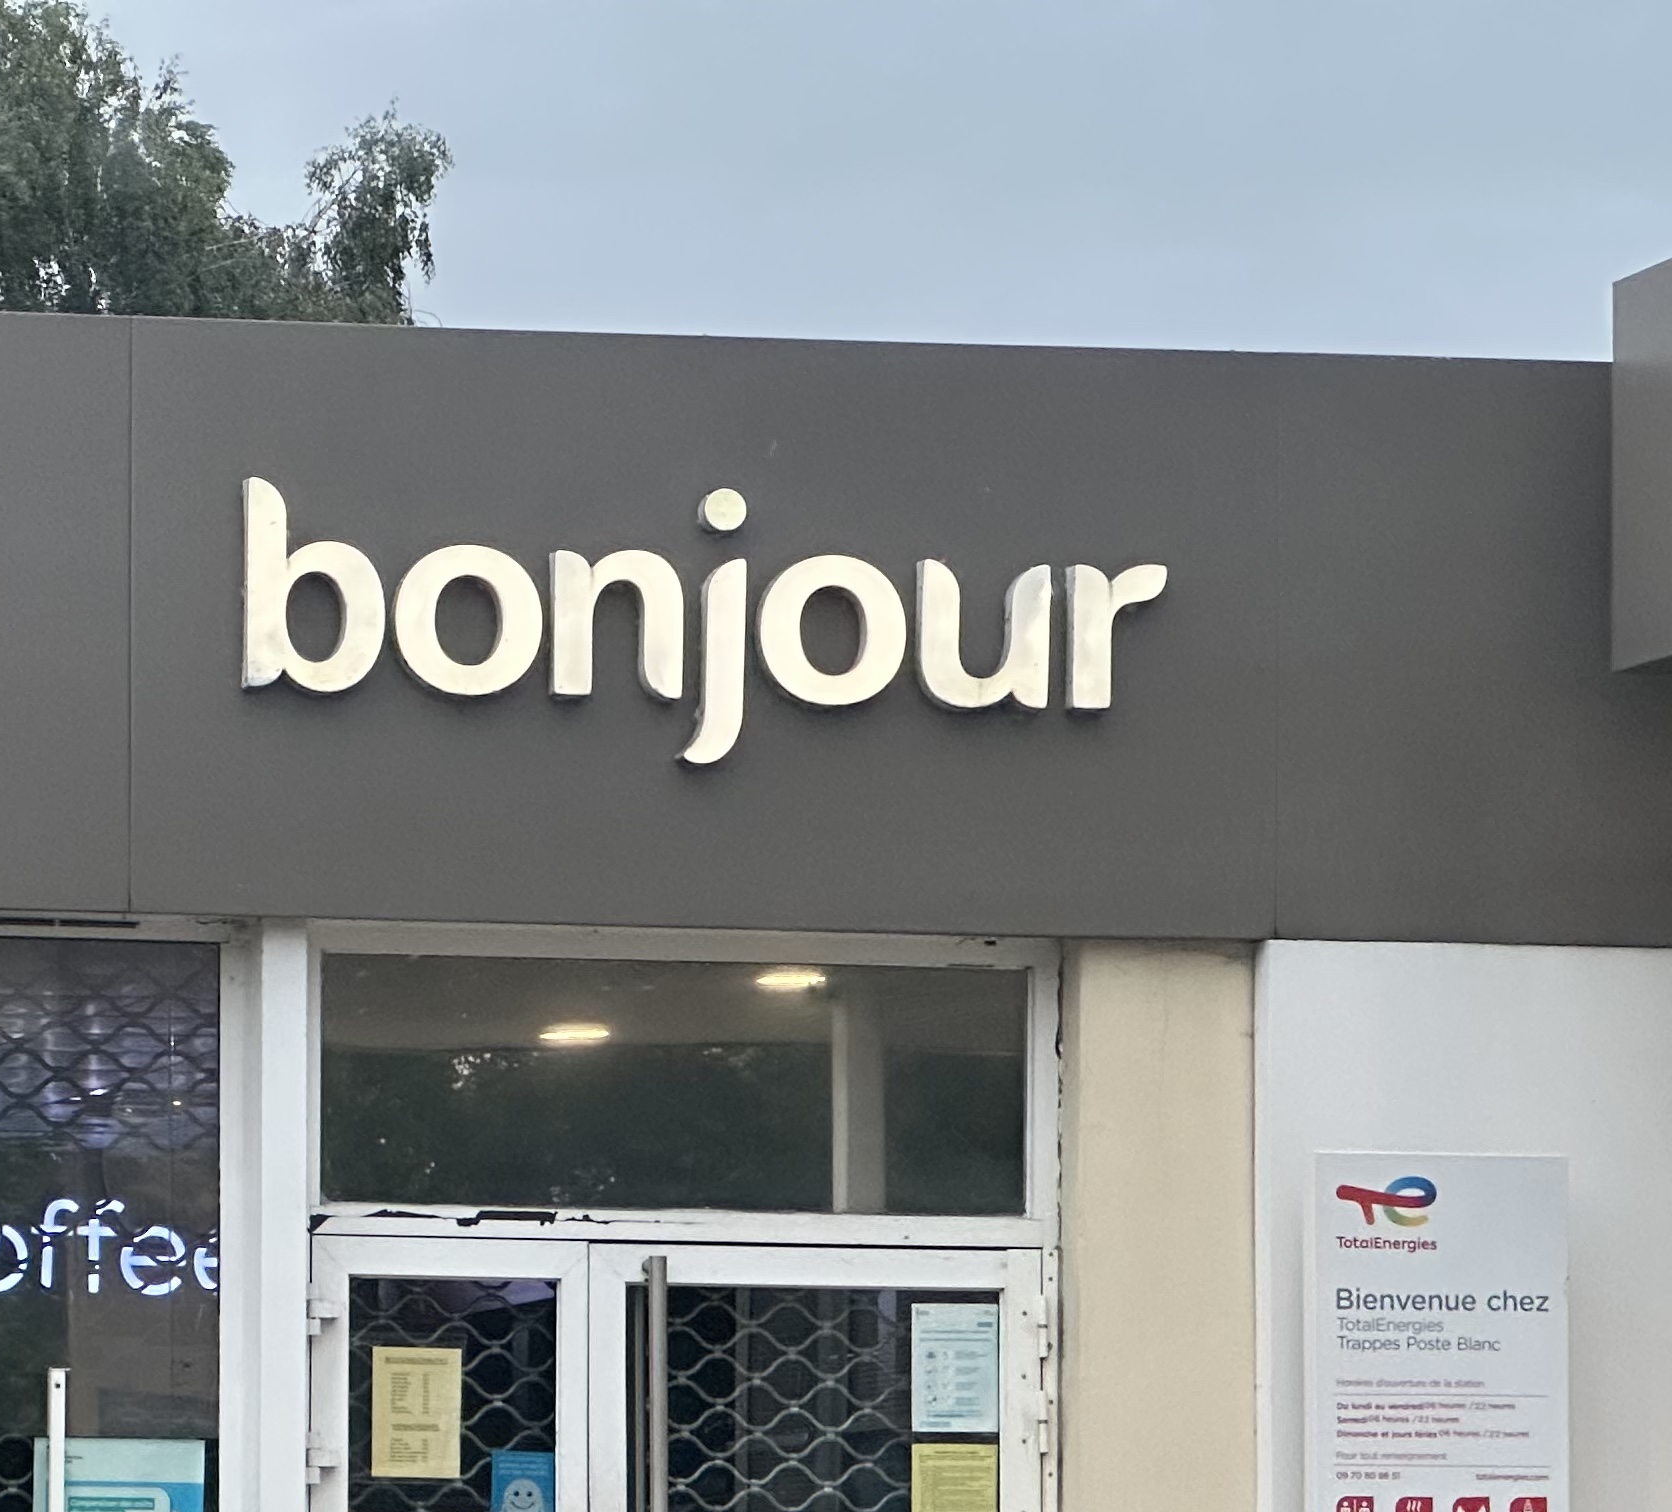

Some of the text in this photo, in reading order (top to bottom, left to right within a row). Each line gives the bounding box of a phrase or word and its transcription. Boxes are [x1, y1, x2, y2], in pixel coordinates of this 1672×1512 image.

[241, 476, 1168, 766] bonjour
[1336, 1236, 1438, 1253] TotalEnergies
[1336, 1288, 1550, 1312] Bienvenue chez
[1337, 1317, 1444, 1335] TotalEnergies
[1337, 1335, 1502, 1353] Trappes Poste Blanc
